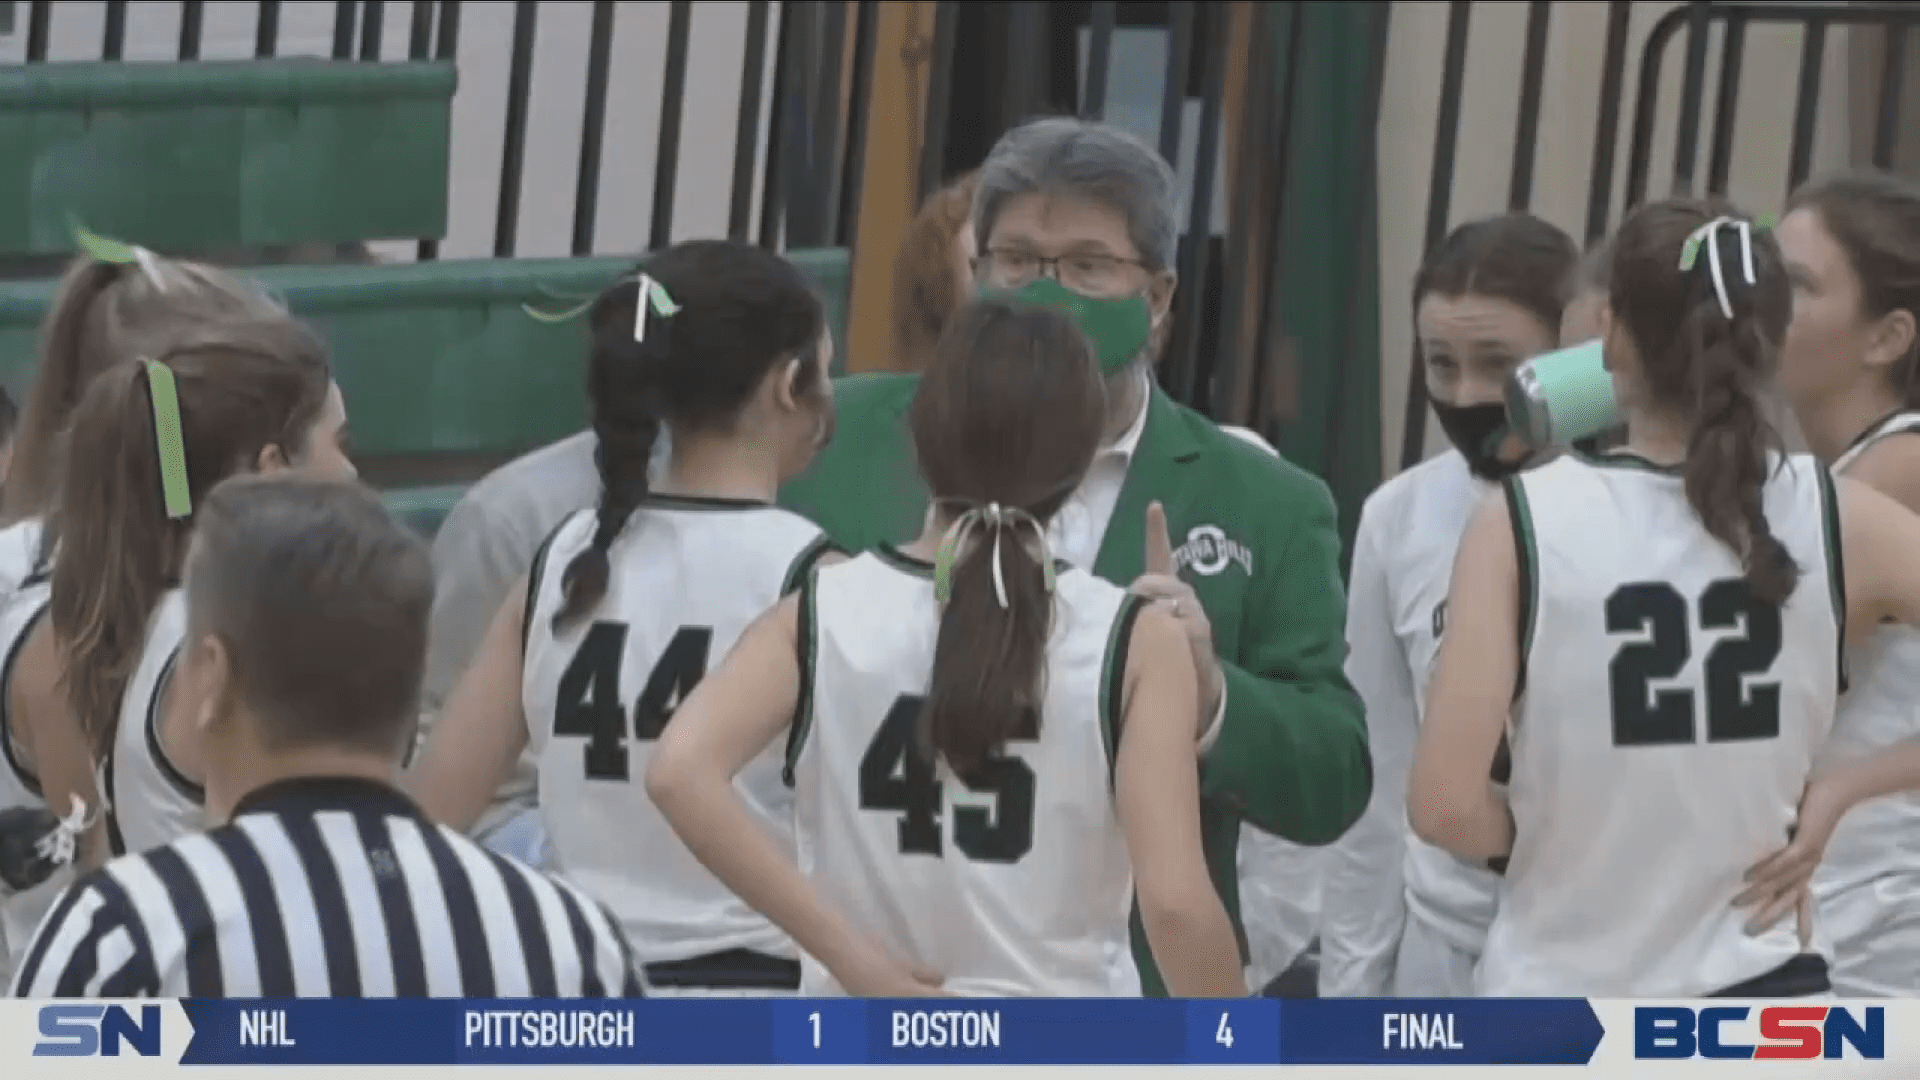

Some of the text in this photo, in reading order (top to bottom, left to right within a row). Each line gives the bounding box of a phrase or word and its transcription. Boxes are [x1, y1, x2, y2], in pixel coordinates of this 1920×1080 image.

[553, 620, 713, 781] 44
[1604, 577, 1783, 747] 22
[858, 693, 1041, 864] 45
